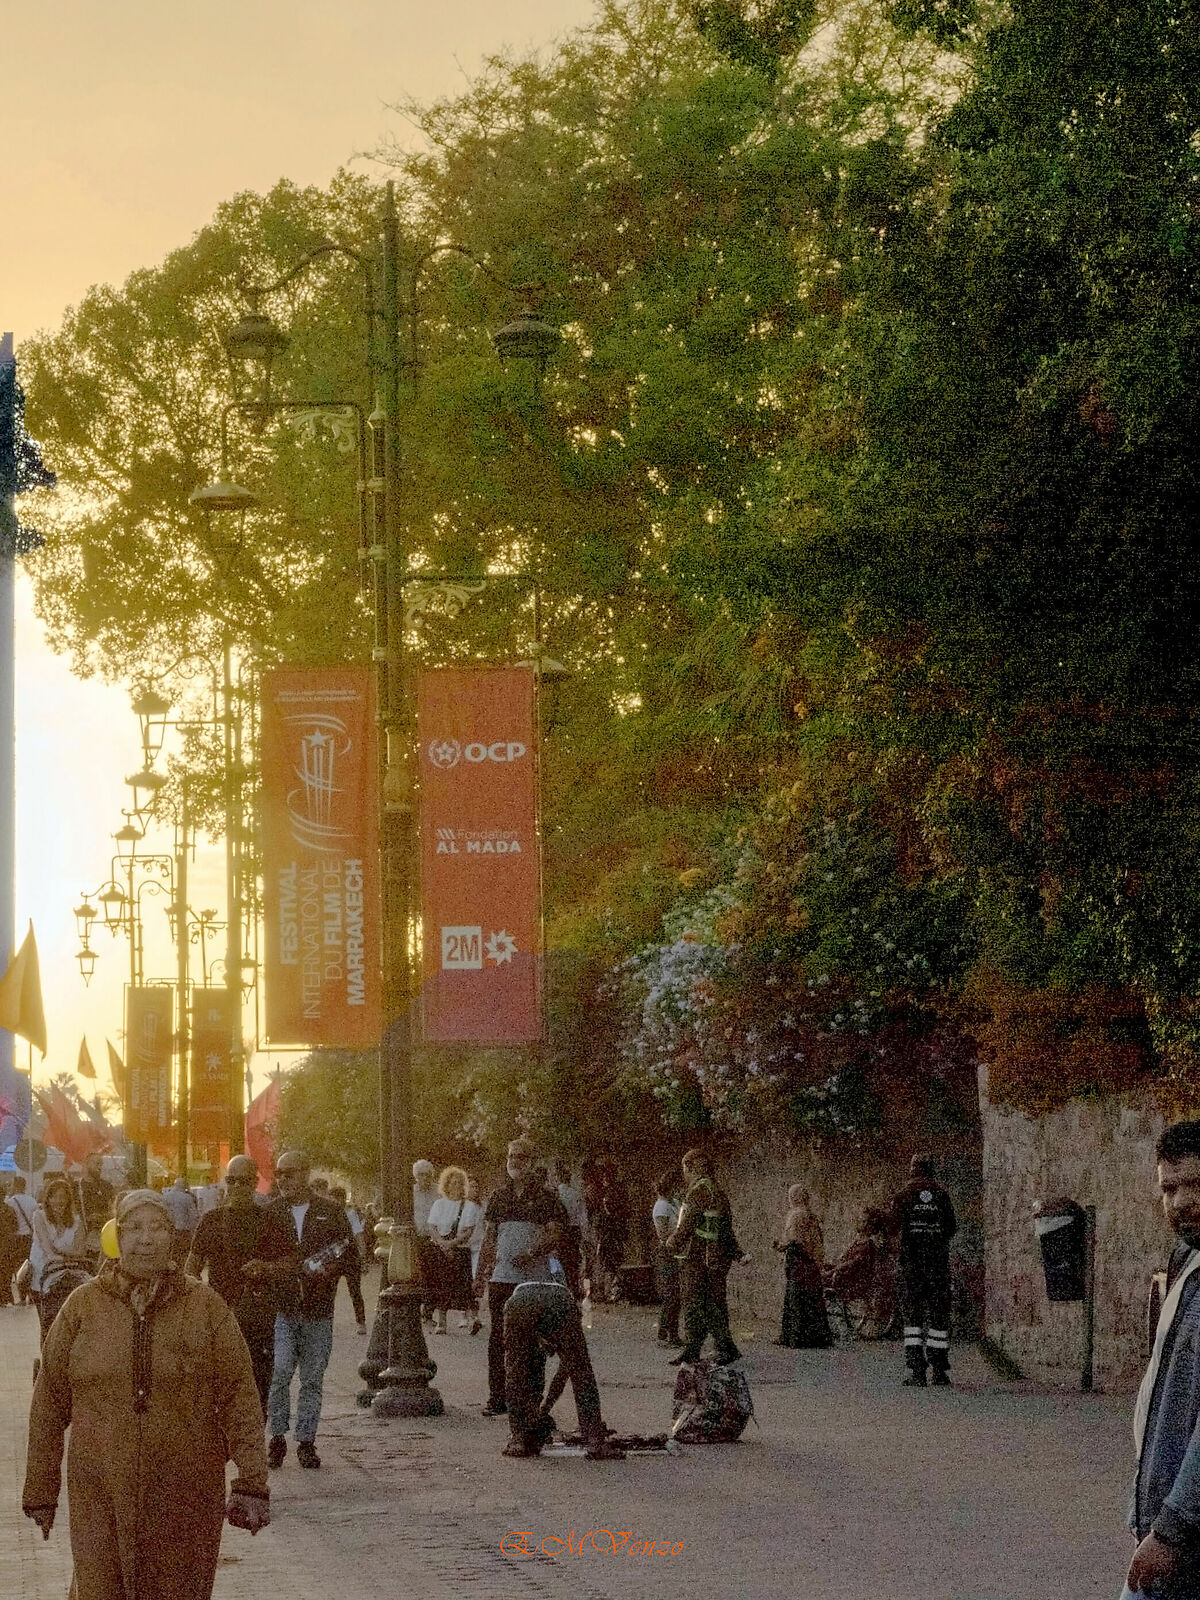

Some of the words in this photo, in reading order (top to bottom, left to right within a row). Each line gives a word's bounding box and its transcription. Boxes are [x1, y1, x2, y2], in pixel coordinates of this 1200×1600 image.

[464, 742, 526, 763] OCP
[436, 840, 459, 854] AL
[466, 840, 522, 854] MADA
[457, 828, 518, 840] Fondation
[322, 858, 341, 888] DE
[280, 861, 298, 964] FESTIVAL
[323, 893, 342, 945] FILM
[301, 861, 320, 1018] INTERNATIONAL
[345, 858, 365, 1005] MARRAKECH
[445, 934, 480, 963] 2M
[324, 951, 342, 979] DU
